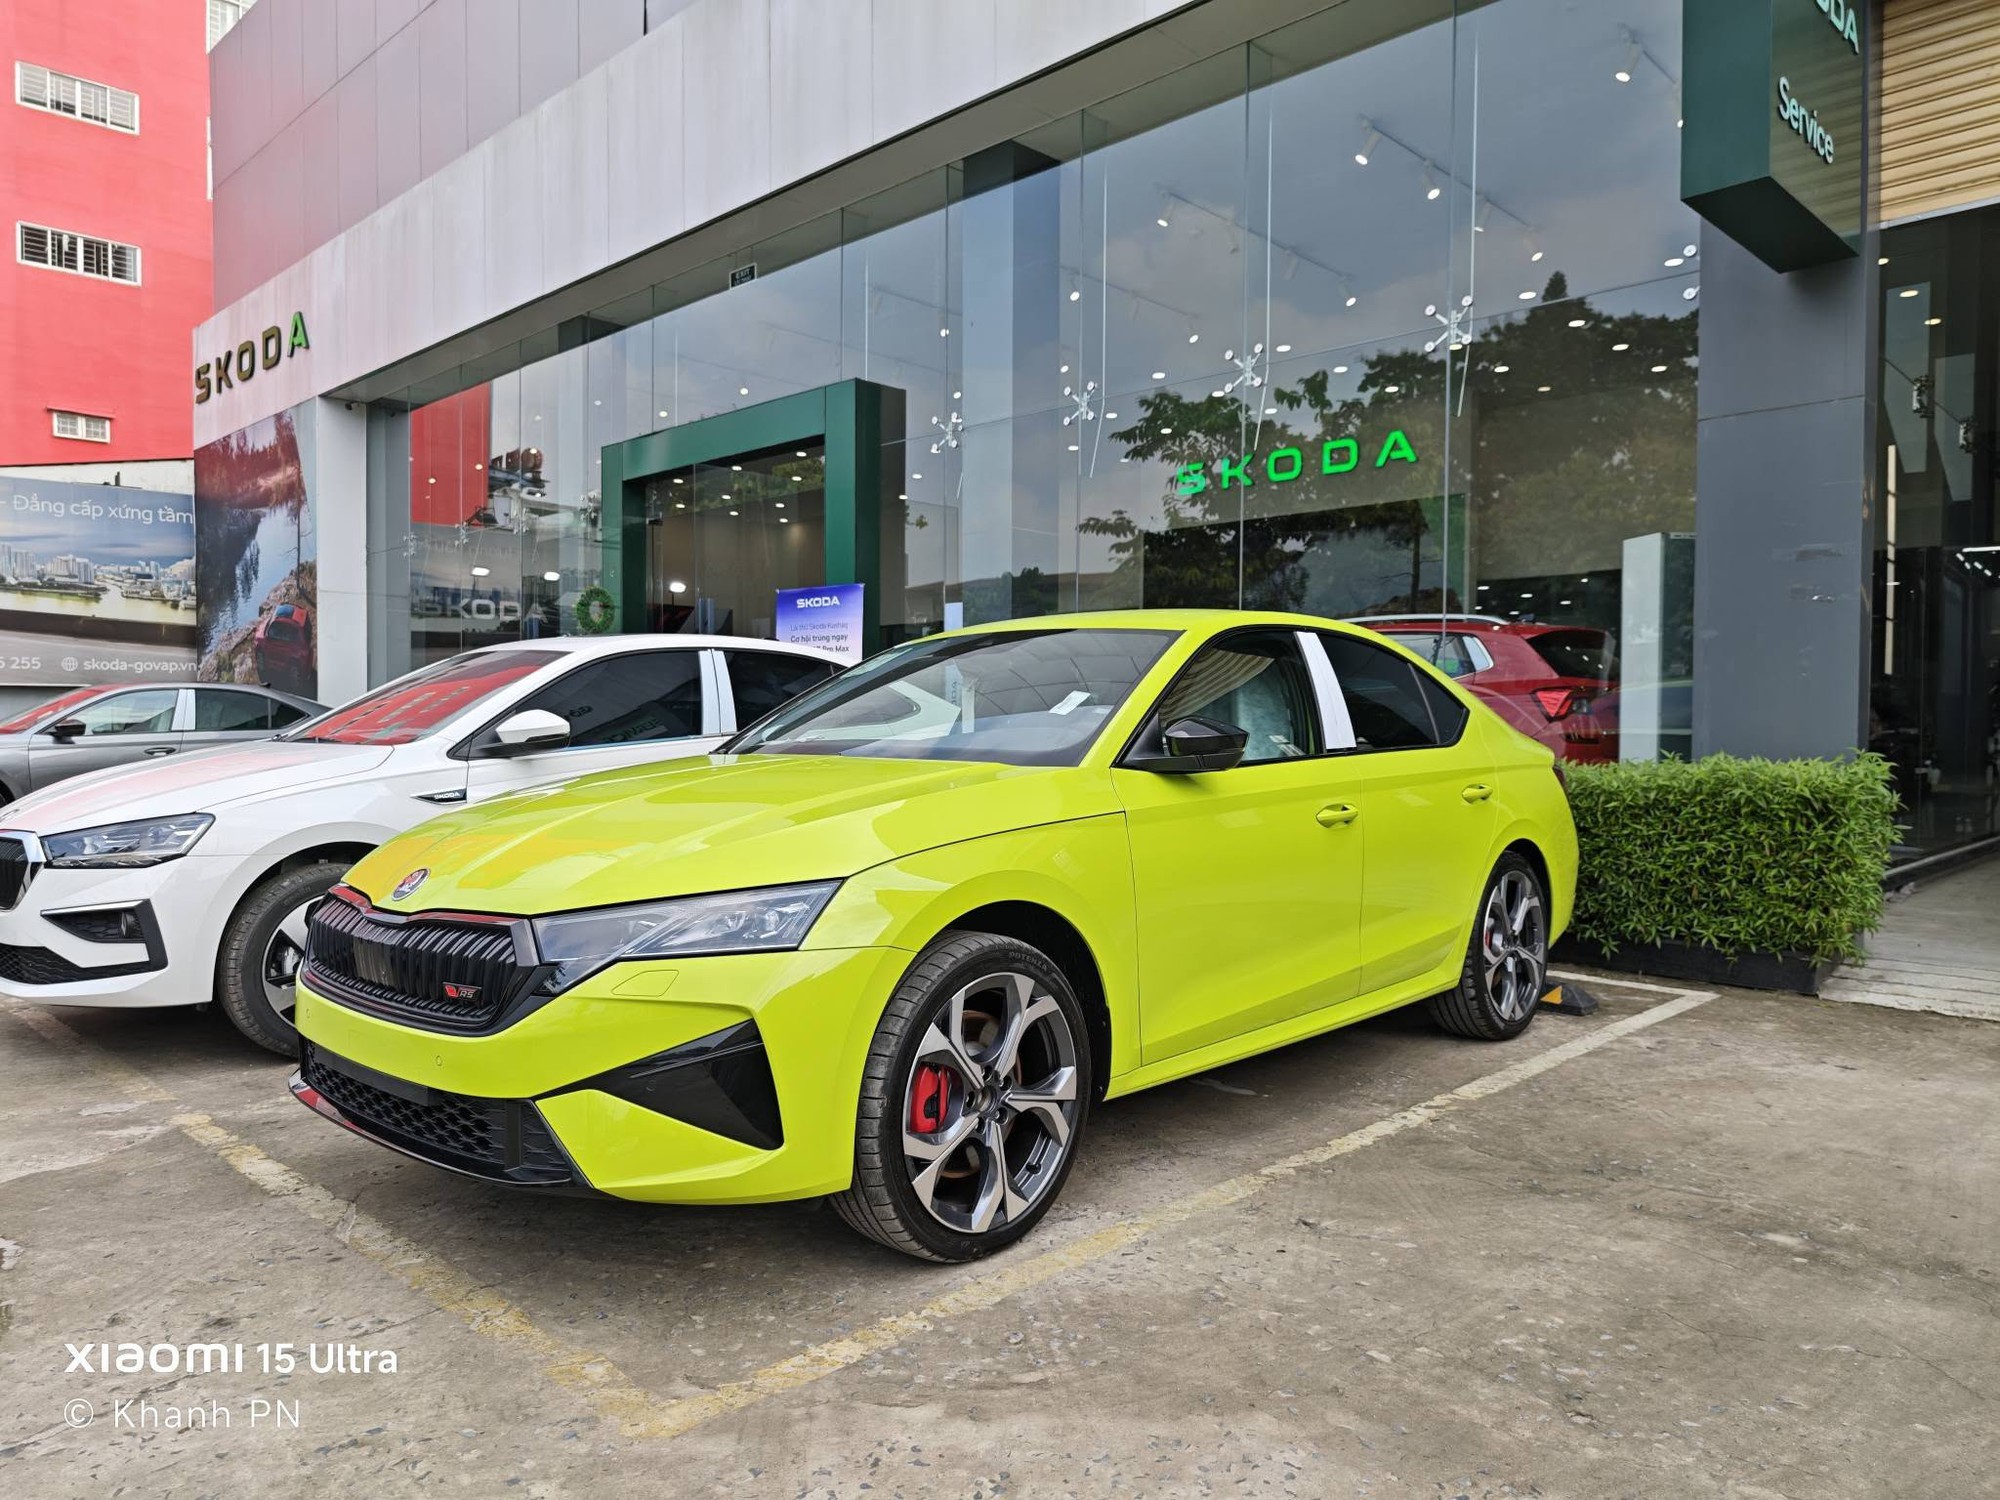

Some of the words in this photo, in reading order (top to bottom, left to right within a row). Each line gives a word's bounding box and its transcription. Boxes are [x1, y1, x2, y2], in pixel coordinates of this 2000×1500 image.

[1779, 76, 1834, 164] Service
[195, 311, 309, 404] SKODA
[1176, 430, 1417, 495] SKODA
[70, 499, 103, 520] cấp
[108, 504, 153, 524] xứng
[157, 505, 193, 524] tầm
[796, 595, 840, 609] SKODA
[10, 656, 41, 669] 255
[83, 658, 197, 674] skoda-govap.vn
